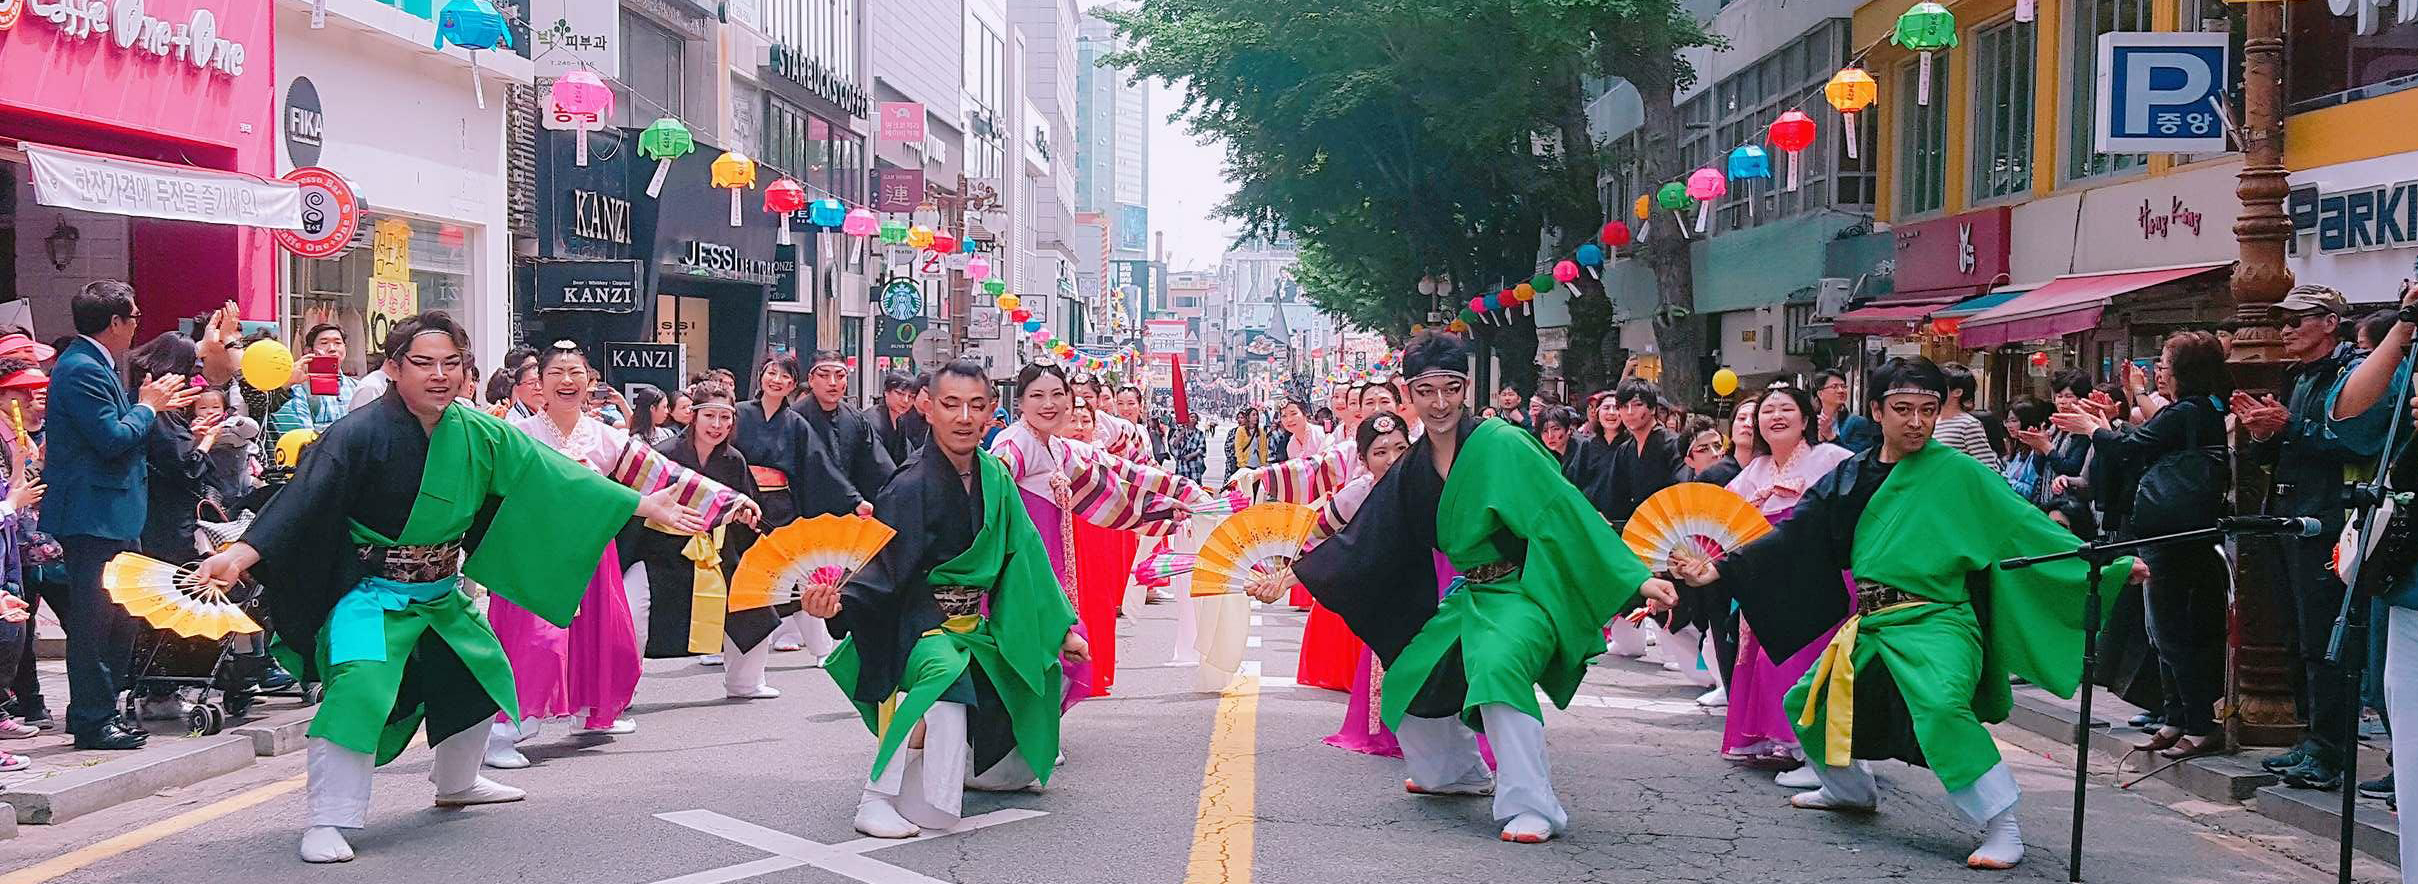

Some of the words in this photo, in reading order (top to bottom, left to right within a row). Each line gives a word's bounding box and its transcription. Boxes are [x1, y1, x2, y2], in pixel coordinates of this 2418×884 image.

[565, 34, 607, 51] 피부과
[779, 41, 838, 104] STARBUCKS
[2125, 52, 2212, 134] P
[290, 106, 324, 139] FIKA
[2156, 112, 2213, 135] 중앙
[73, 165, 150, 206] 한잔가격에
[154, 177, 198, 213] 두잔을
[885, 183, 912, 207] 連
[574, 188, 632, 245] KANZI
[684, 239, 738, 281] JESSI
[563, 287, 632, 304] KANZI
[612, 350, 673, 369] KANZI
